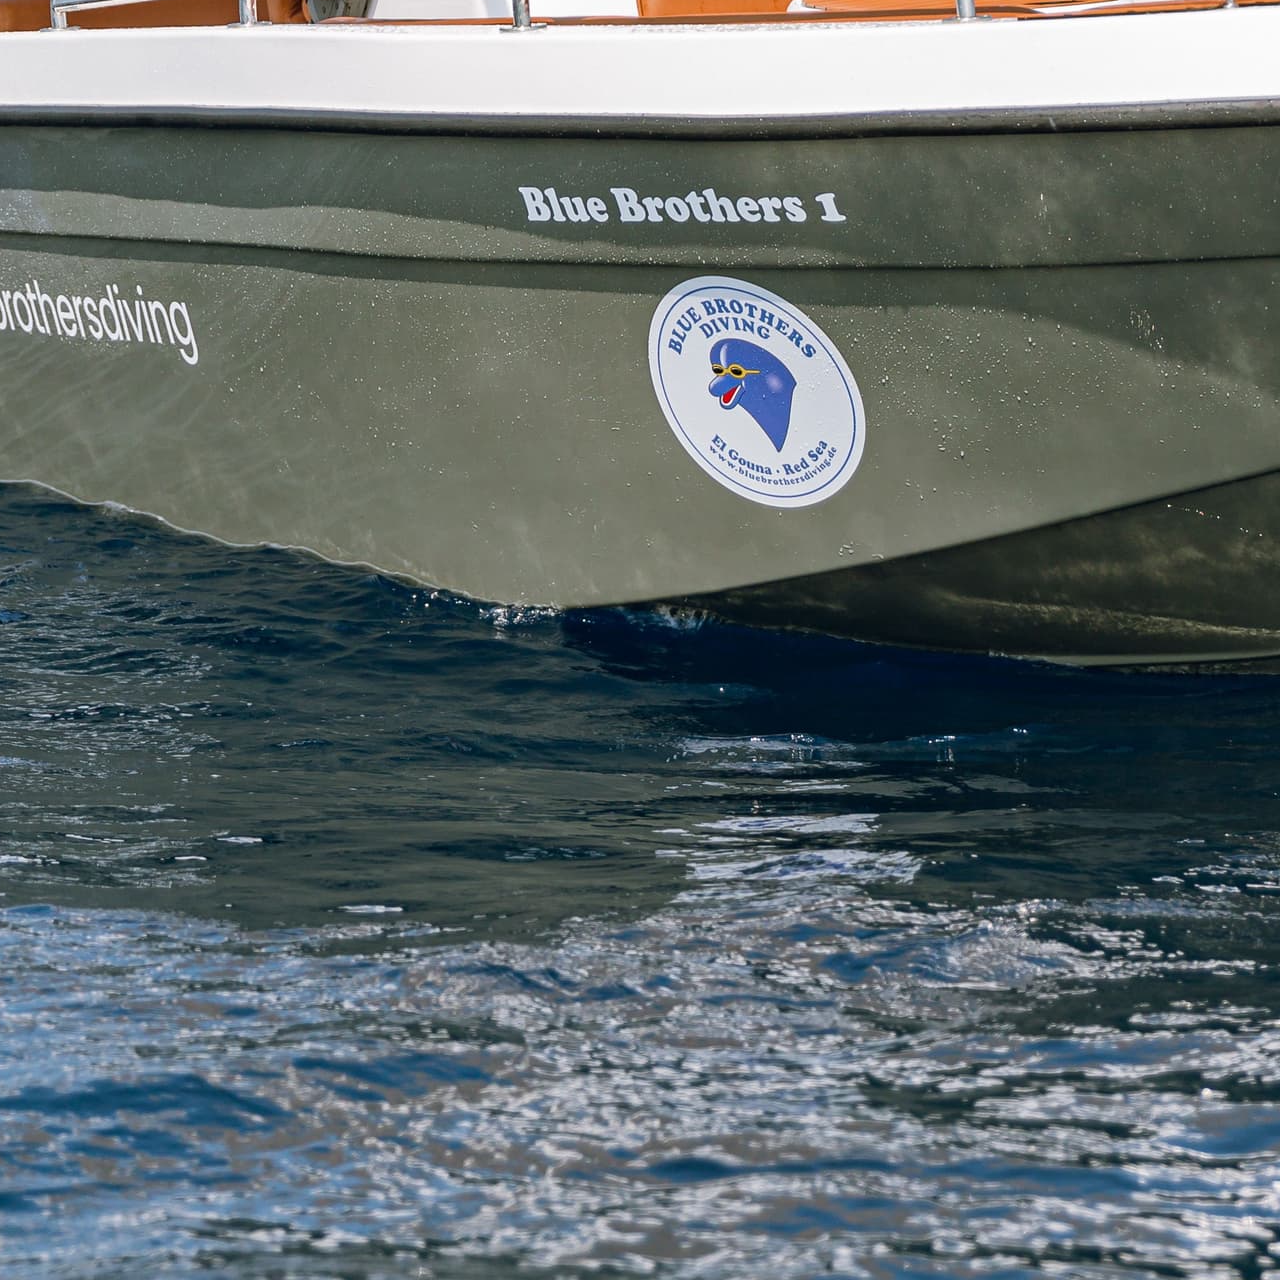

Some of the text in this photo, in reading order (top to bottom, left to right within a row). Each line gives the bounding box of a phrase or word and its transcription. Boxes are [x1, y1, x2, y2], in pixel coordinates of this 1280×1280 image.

[518, 187, 846, 223] Blue Brothers 1
[668, 298, 817, 358] BLUE BROTHERS
[699, 316, 771, 340] DIVING
[709, 446, 838, 486] www.bluebrothersdiving.de
[711, 434, 828, 475] El Gouna Red Sea
